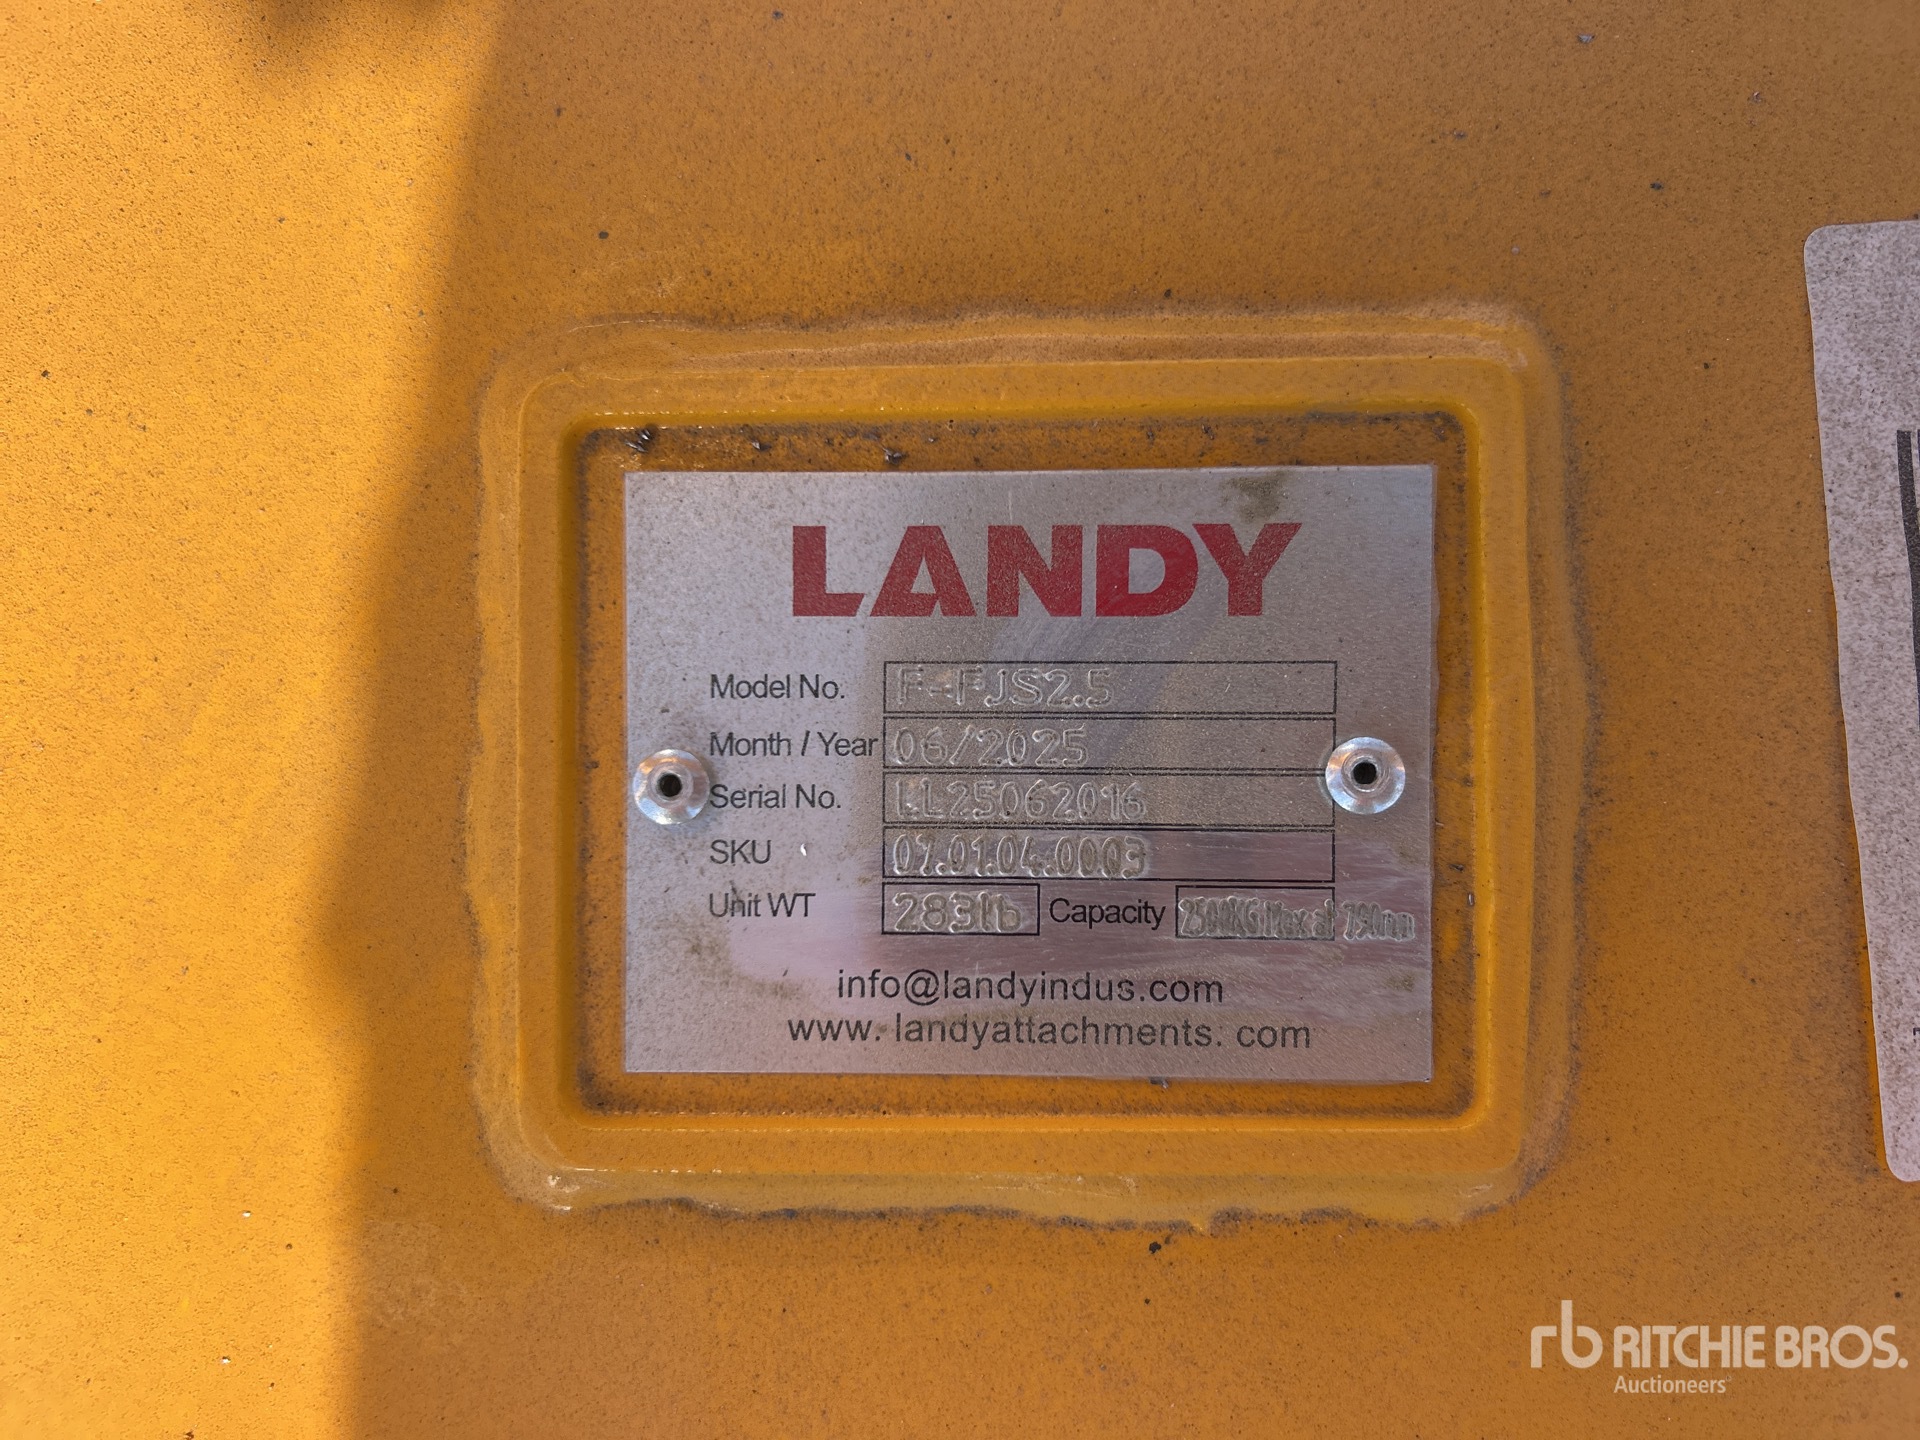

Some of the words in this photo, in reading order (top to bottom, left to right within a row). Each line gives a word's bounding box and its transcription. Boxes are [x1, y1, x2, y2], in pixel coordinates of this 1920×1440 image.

[792, 522, 1302, 618] LANDY
[710, 673, 791, 699] Model
[800, 673, 846, 699] No.
[897, 666, 1115, 708] F-FJS2.5
[710, 732, 791, 757] Month
[800, 731, 809, 757] /
[817, 731, 879, 757] Year
[893, 724, 1089, 767] 06/2025
[710, 784, 786, 809] Serial
[796, 784, 841, 809] No.
[896, 779, 1148, 822] LL25062016
[710, 840, 771, 864] SKU
[709, 892, 760, 918] Unit
[770, 893, 816, 917] WT
[893, 890, 1023, 933] 283lb
[1049, 897, 1166, 930] Capacity
[838, 968, 1225, 1006] info@landyindus.com
